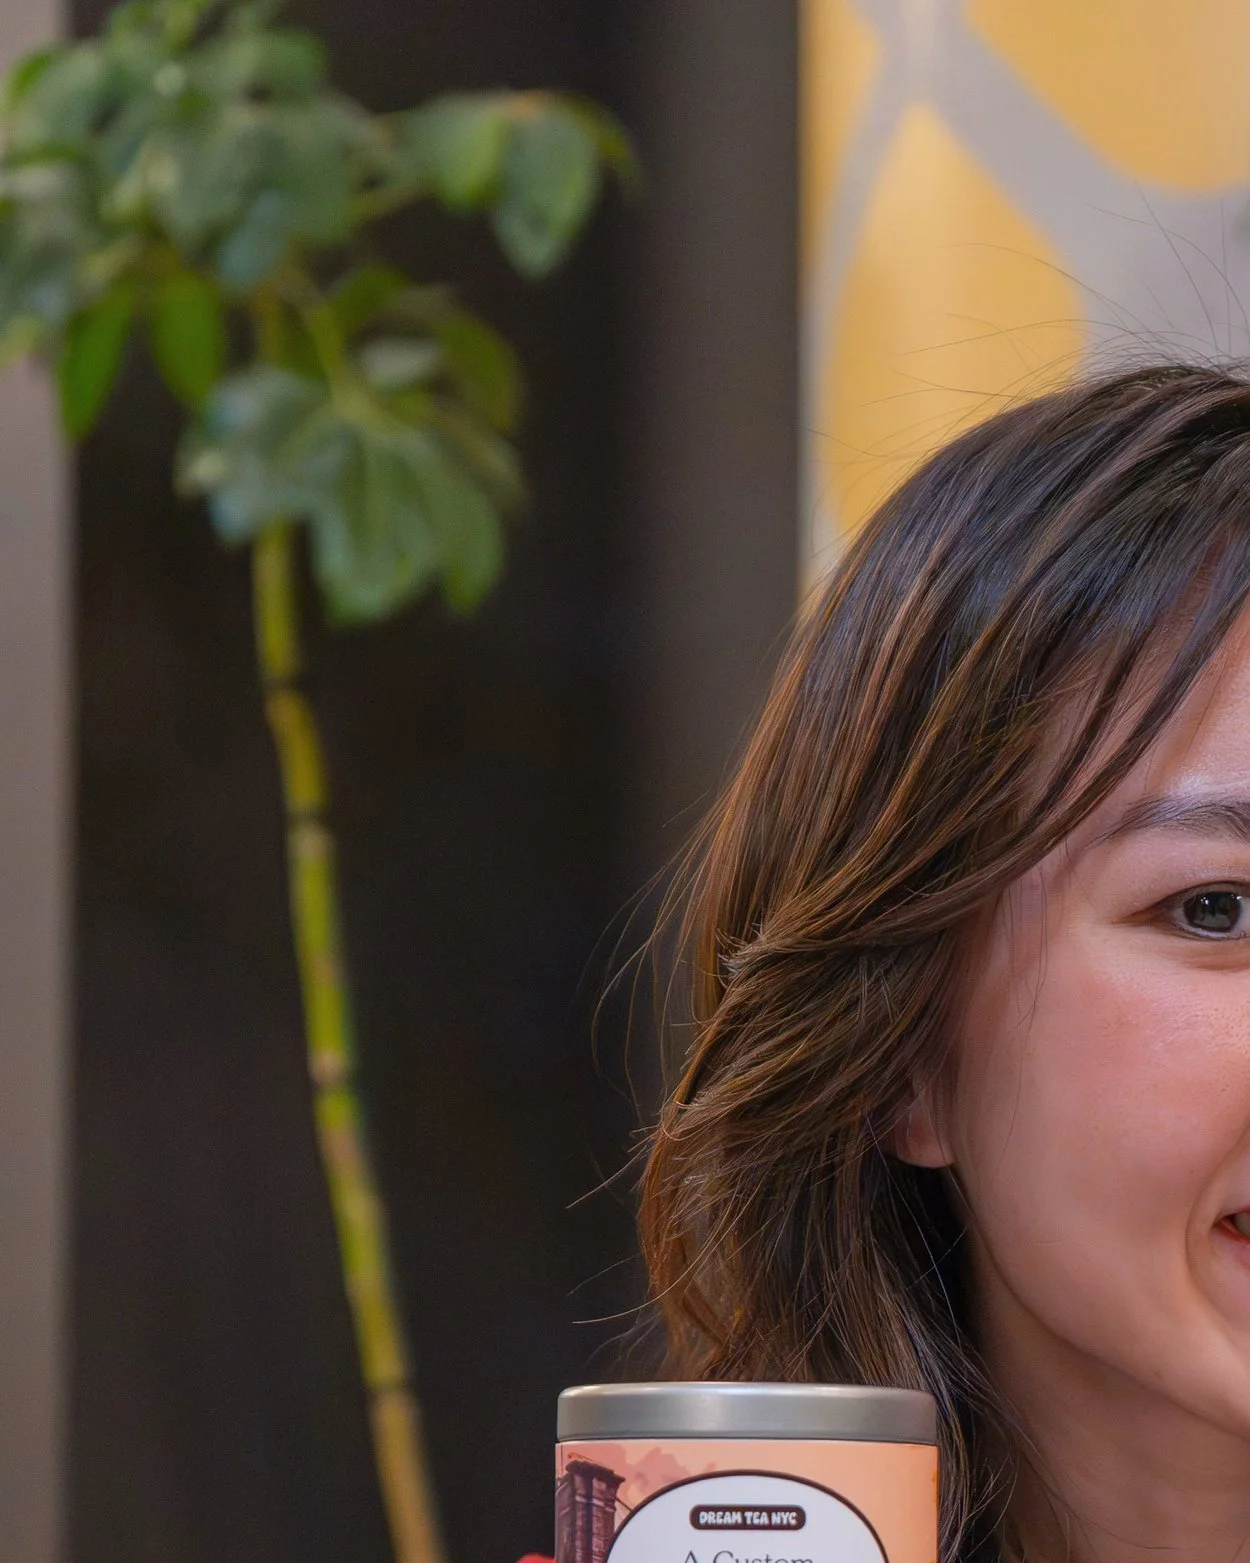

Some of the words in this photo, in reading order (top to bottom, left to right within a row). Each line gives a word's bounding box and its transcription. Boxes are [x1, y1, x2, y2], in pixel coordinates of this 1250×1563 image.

[699, 1511, 742, 1524] DREAM
[744, 1512, 769, 1525] TEA
[771, 1512, 797, 1525] NYC
